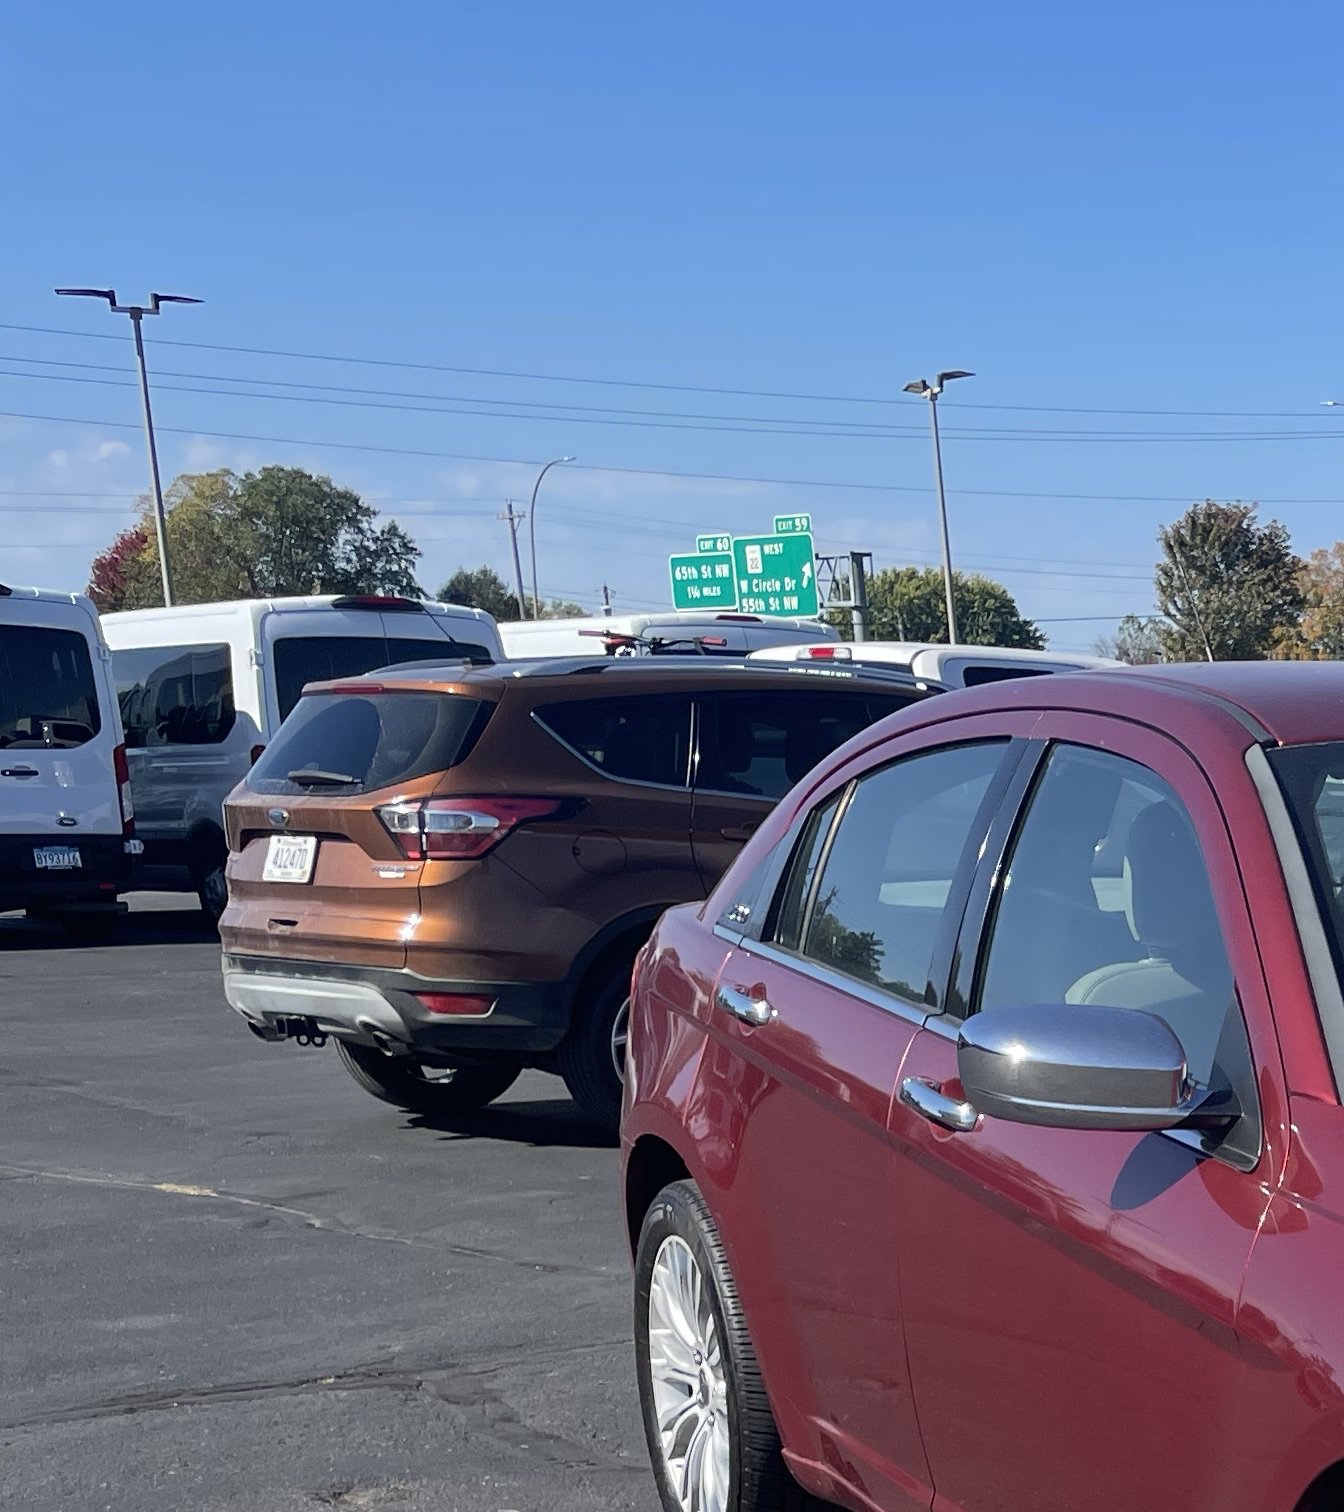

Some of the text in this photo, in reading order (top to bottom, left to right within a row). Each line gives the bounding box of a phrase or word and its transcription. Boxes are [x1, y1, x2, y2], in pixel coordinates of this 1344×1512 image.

[778, 518, 807, 531] EXIT 59
[700, 538, 729, 551] EXIT 60
[763, 543, 783, 555] WEST
[749, 557, 759, 570] 22
[674, 564, 729, 580] 65th St NW
[702, 586, 721, 597] MILES
[740, 577, 796, 593] W Circle Dr
[742, 596, 798, 612] 55th St NW
